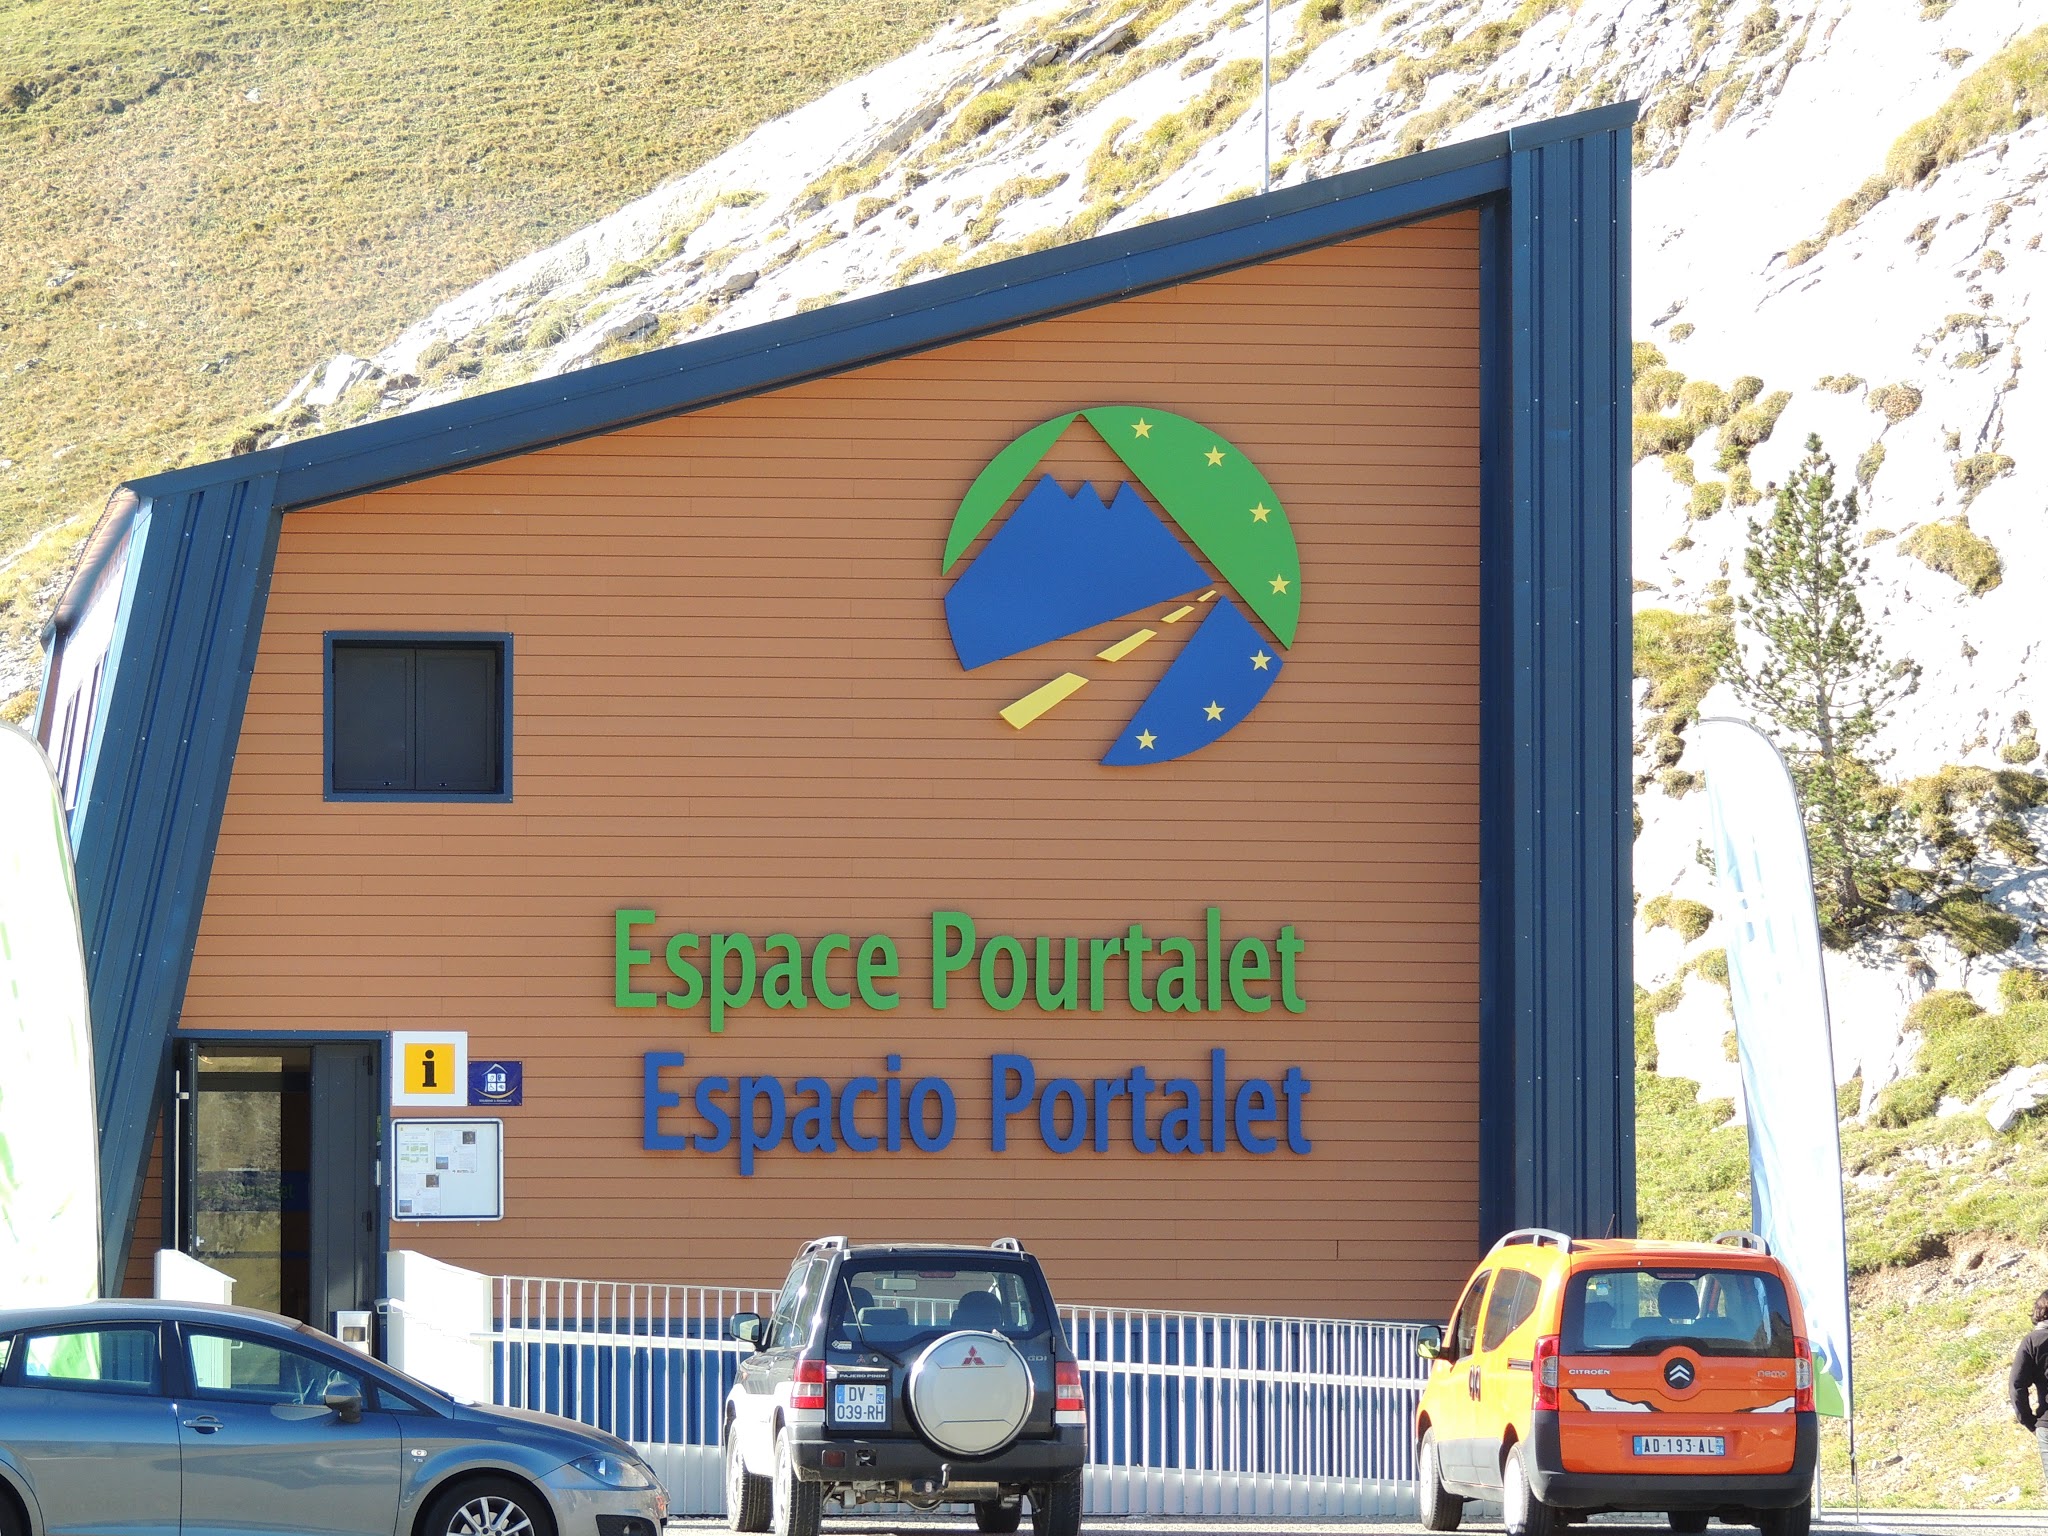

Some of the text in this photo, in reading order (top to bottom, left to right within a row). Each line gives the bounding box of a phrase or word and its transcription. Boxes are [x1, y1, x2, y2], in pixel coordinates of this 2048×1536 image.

[614, 907, 1307, 1034] Espace Pourtalet
[642, 1048, 1312, 1177] Espacio Portalet
[837, 1405, 884, 1420] 039-RH
